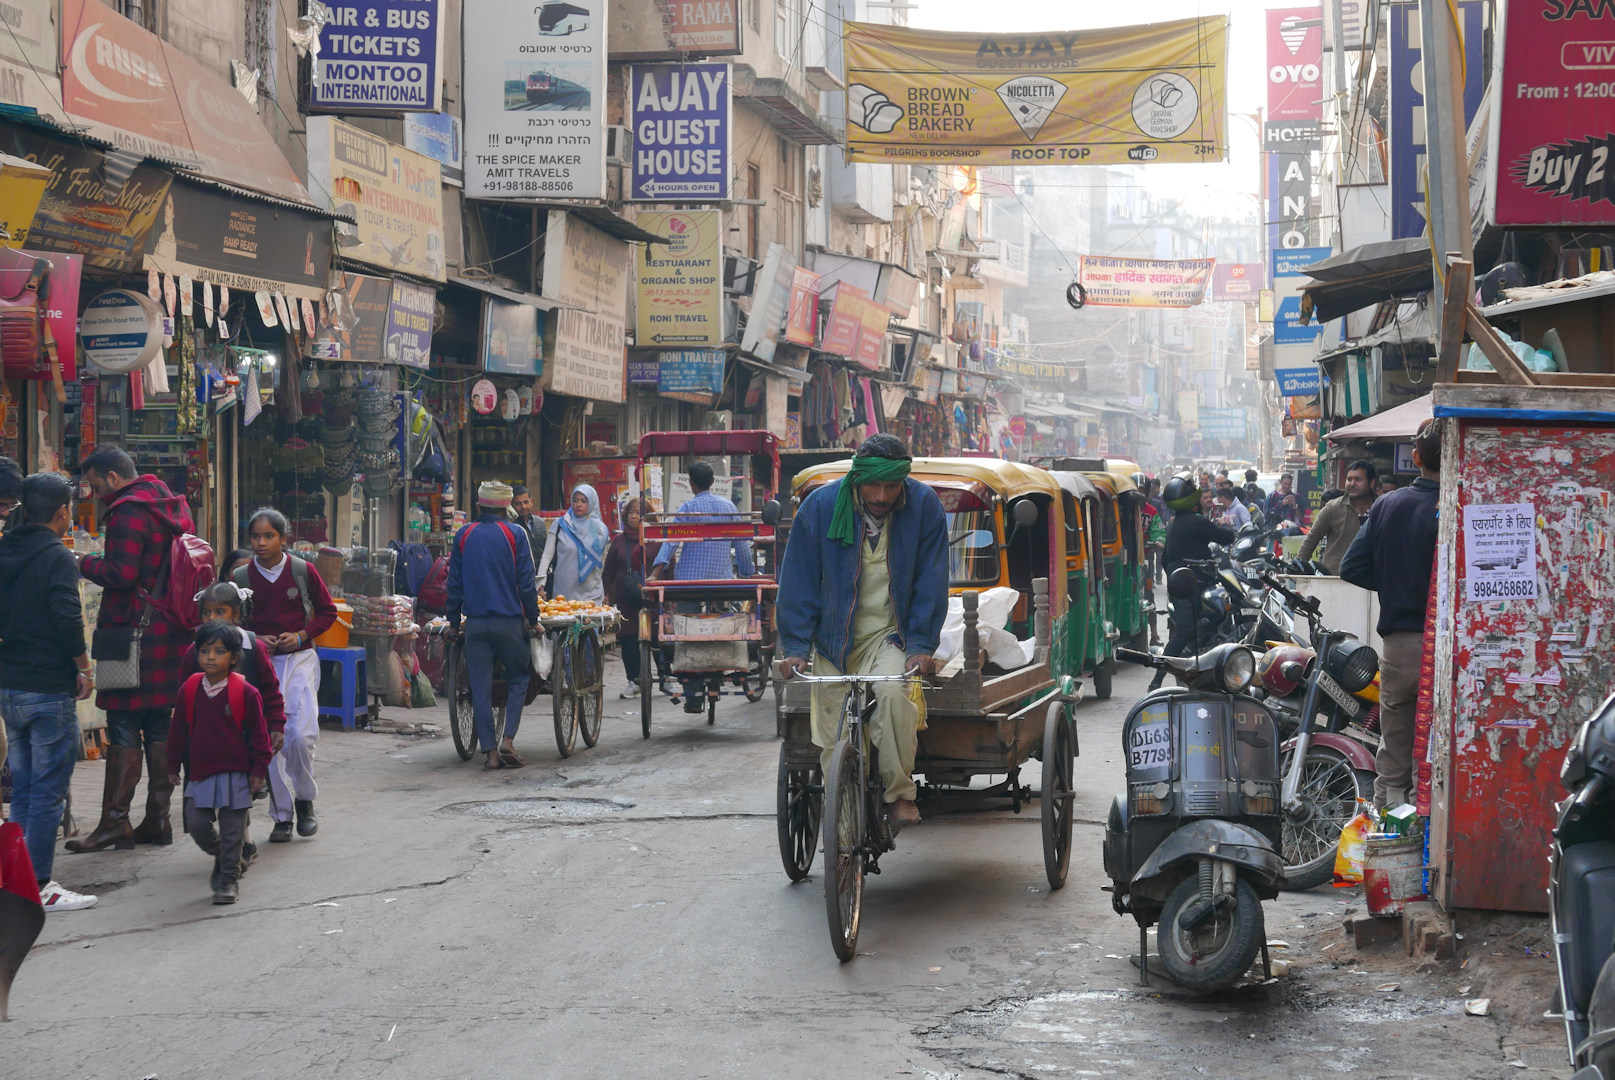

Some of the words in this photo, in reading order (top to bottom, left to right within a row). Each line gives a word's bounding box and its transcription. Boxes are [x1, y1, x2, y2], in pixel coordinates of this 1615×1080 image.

[325, 7, 358, 26] AIR
[364, 8, 380, 27] &
[387, 9, 430, 30] BUS
[682, 1, 735, 26] RAMA
[329, 34, 420, 57] TICKETS
[974, 33, 1080, 58] AJAY
[976, 58, 1023, 70] GUEST
[1026, 58, 1080, 69] HOUSE
[326, 64, 422, 82] MONTOO
[1269, 63, 1320, 84] OYO
[321, 83, 425, 102] INTERNATIONAL
[637, 71, 726, 112] AJAY
[908, 88, 970, 101] BROWN
[1007, 85, 1055, 97] NICOLETTA
[1517, 83, 1559, 98] From
[908, 103, 964, 116] BREAD
[528, 118, 555, 127] רכבת
[908, 118, 975, 131] BAKERY
[638, 119, 721, 146] GUEST
[1267, 127, 1321, 142] HOTEL
[488, 134, 499, 148] !!!
[476, 155, 499, 165] THE
[502, 155, 535, 165] SPICE
[539, 155, 581, 165] MAKER
[884, 148, 928, 157] PILGRIMS
[930, 149, 981, 158] BOOKSHOP
[1011, 147, 1057, 160] ROOF
[1060, 147, 1091, 160] TOP
[638, 149, 722, 175] HOUSE
[486, 169, 514, 178] AMIT
[518, 169, 570, 178] TRAVELS
[1526, 147, 1582, 195] Buy
[1586, 146, 1609, 185] 2
[483, 181, 574, 191] +91-98188-88506
[645, 183, 656, 192] 24
[362, 185, 439, 227] INTERNATIONAL
[229, 219, 256, 235] RADIANCE
[224, 236, 239, 248] RAMP
[240, 239, 258, 252] READY
[645, 259, 712, 267] RESTUARANT
[197, 269, 216, 281] JAGAN
[216, 272, 231, 285] NATH
[237, 276, 252, 289] SONS
[675, 268, 682, 276] &
[1232, 267, 1245, 277] go
[641, 277, 686, 285] ORGANIC
[689, 276, 716, 285] SHOP
[559, 310, 583, 341] AMIT
[585, 316, 623, 353] TRAVELS
[660, 352, 682, 363] RONI
[684, 352, 723, 364] TRAVELS
[1506, 514, 1514, 529] के
[1516, 513, 1532, 529] लिए
[1474, 580, 1534, 598] 9984268682
